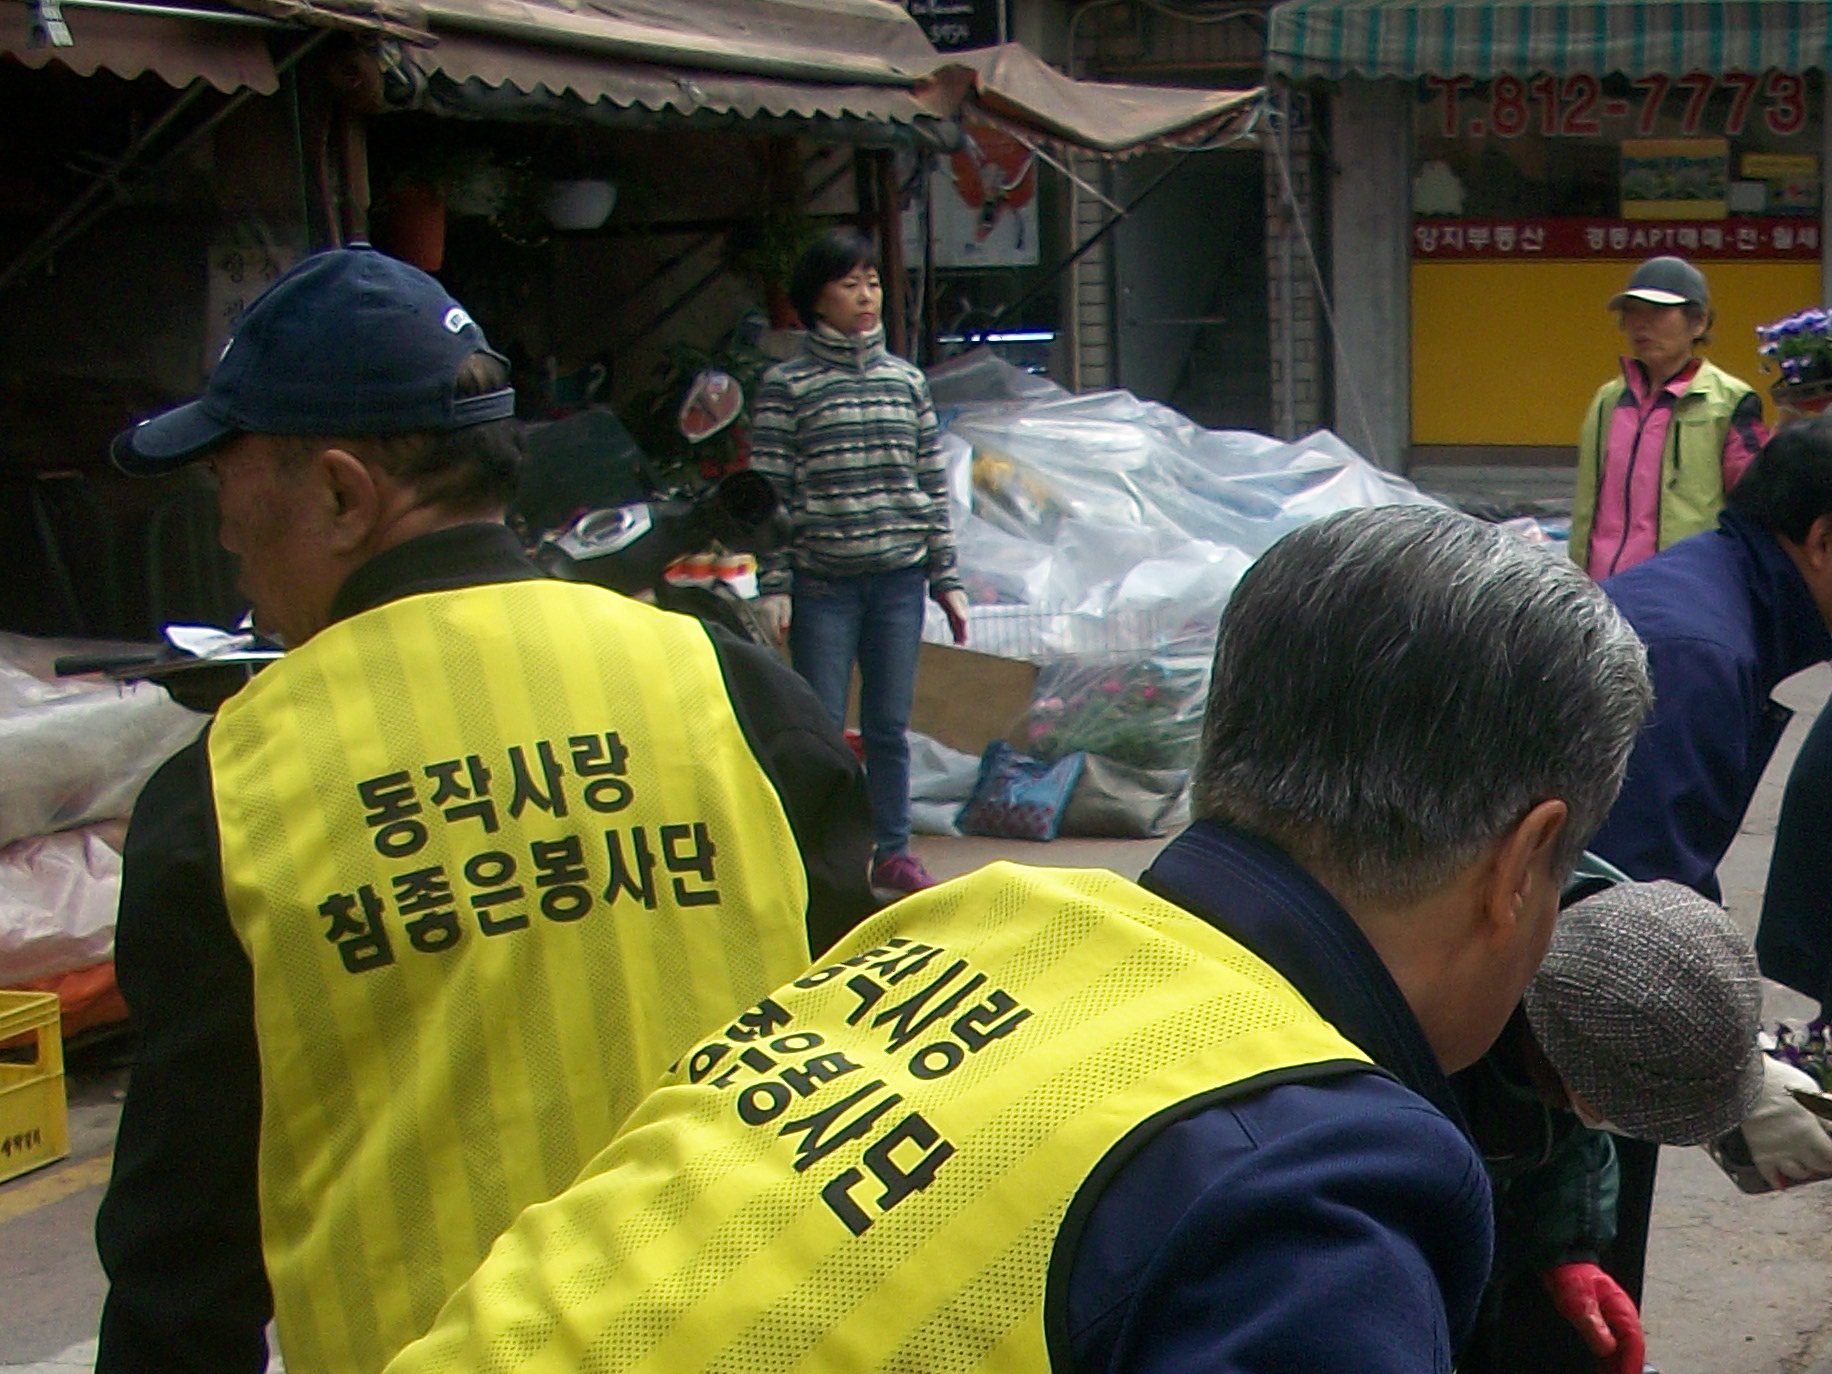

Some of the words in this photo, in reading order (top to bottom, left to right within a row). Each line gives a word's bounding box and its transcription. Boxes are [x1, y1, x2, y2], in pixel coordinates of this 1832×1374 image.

[1415, 227, 1545, 251] 양지부동산
[357, 731, 635, 859] 동작사랑
[317, 821, 722, 975] 참좋은봉사단
[668, 996, 958, 1238] 좋은봉사단
